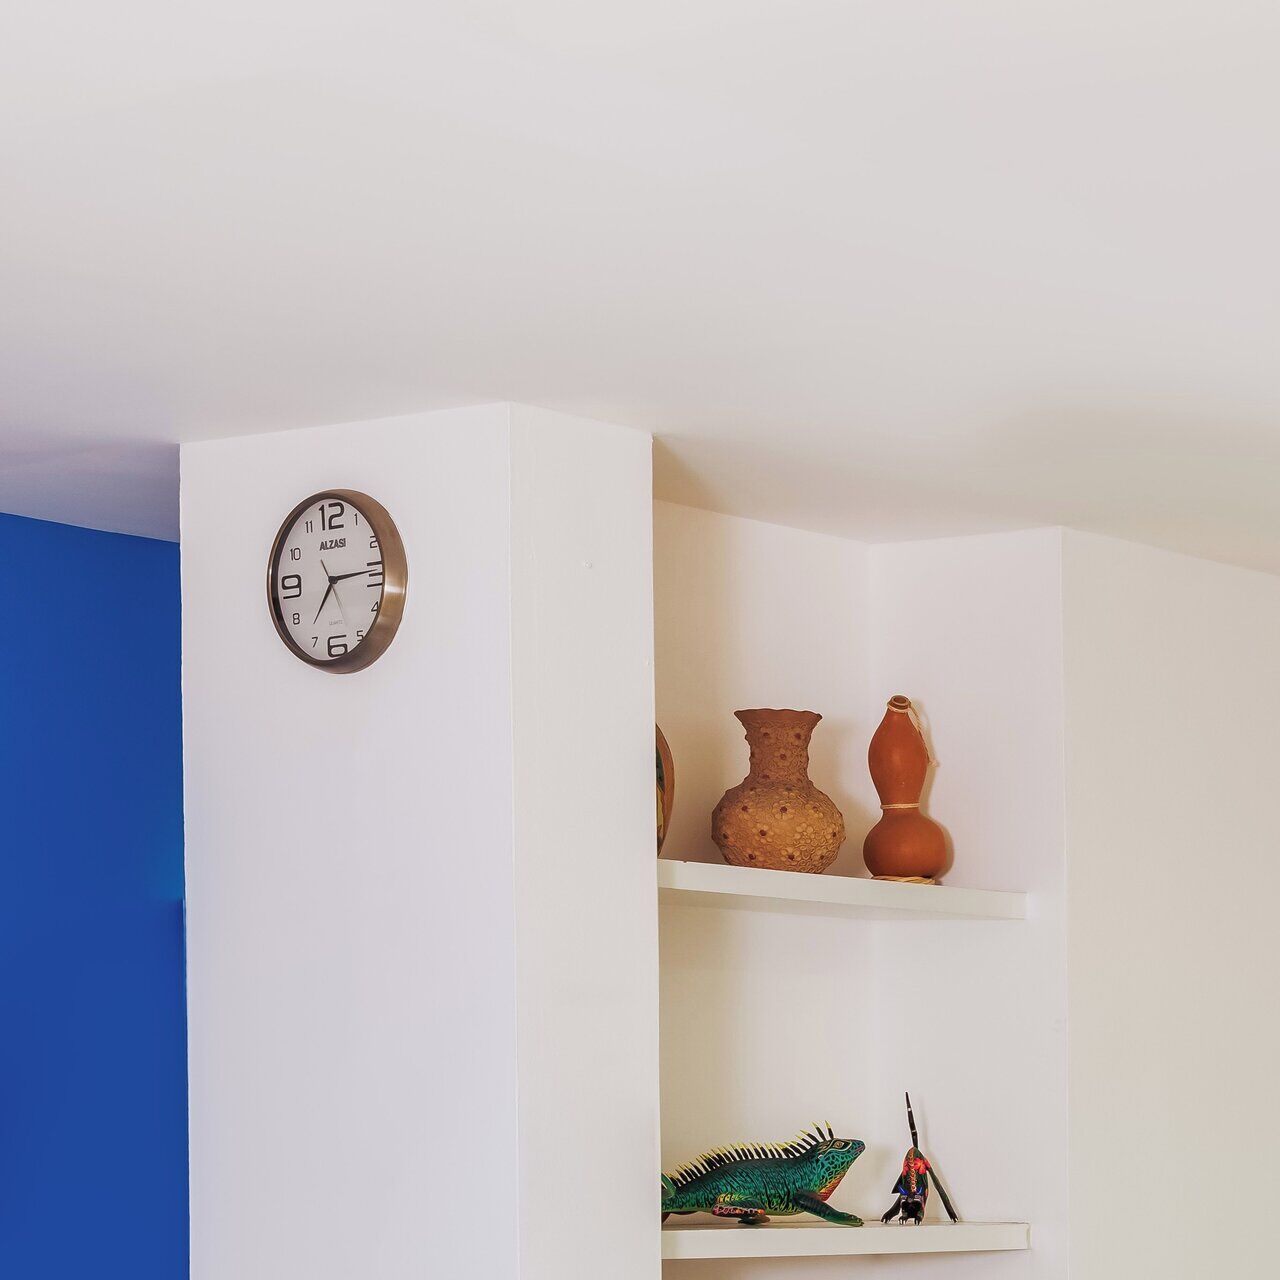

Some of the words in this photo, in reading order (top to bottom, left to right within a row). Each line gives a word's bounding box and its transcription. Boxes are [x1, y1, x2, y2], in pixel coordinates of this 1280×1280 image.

[318, 502, 345, 531] 12
[353, 512, 359, 526] 1
[305, 520, 313, 534] 11
[319, 538, 347, 551] ALZASI
[369, 535, 379, 549] 2
[290, 547, 301, 561] 10
[281, 574, 302, 600] 9
[370, 601, 379, 613] 4
[292, 612, 301, 625] 8
[311, 636, 319, 648] 7
[356, 630, 364, 642] 5
[327, 635, 349, 658] 6
